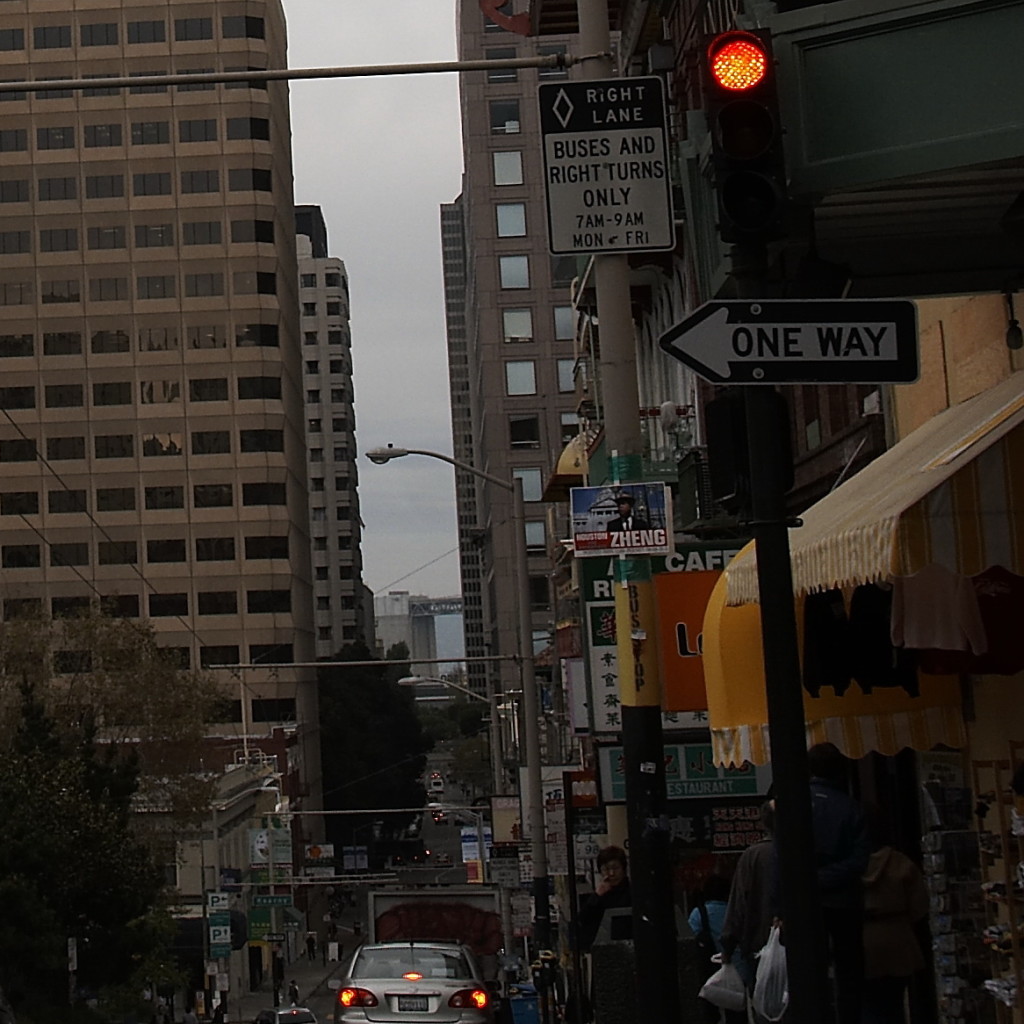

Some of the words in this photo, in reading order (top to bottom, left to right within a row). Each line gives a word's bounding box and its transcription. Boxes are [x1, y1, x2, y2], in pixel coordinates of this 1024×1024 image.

[586, 86, 646, 103] RIGHT
[592, 107, 644, 124] LANE
[554, 138, 610, 159] BUSES
[619, 136, 655, 155] AND
[550, 164, 600, 184] RIGHT
[607, 161, 664, 180] TURNS
[583, 187, 631, 207] ONLY
[576, 212, 644, 228] 7AM-9AM
[573, 233, 604, 247] MON
[626, 231, 649, 245] FRI
[731, 327, 803, 357] ONE
[816, 326, 887, 357] WAY
[610, 529, 666, 548] ZHENG
[629, 585, 640, 628] BUS
[667, 780, 734, 795] ESTAURANT
